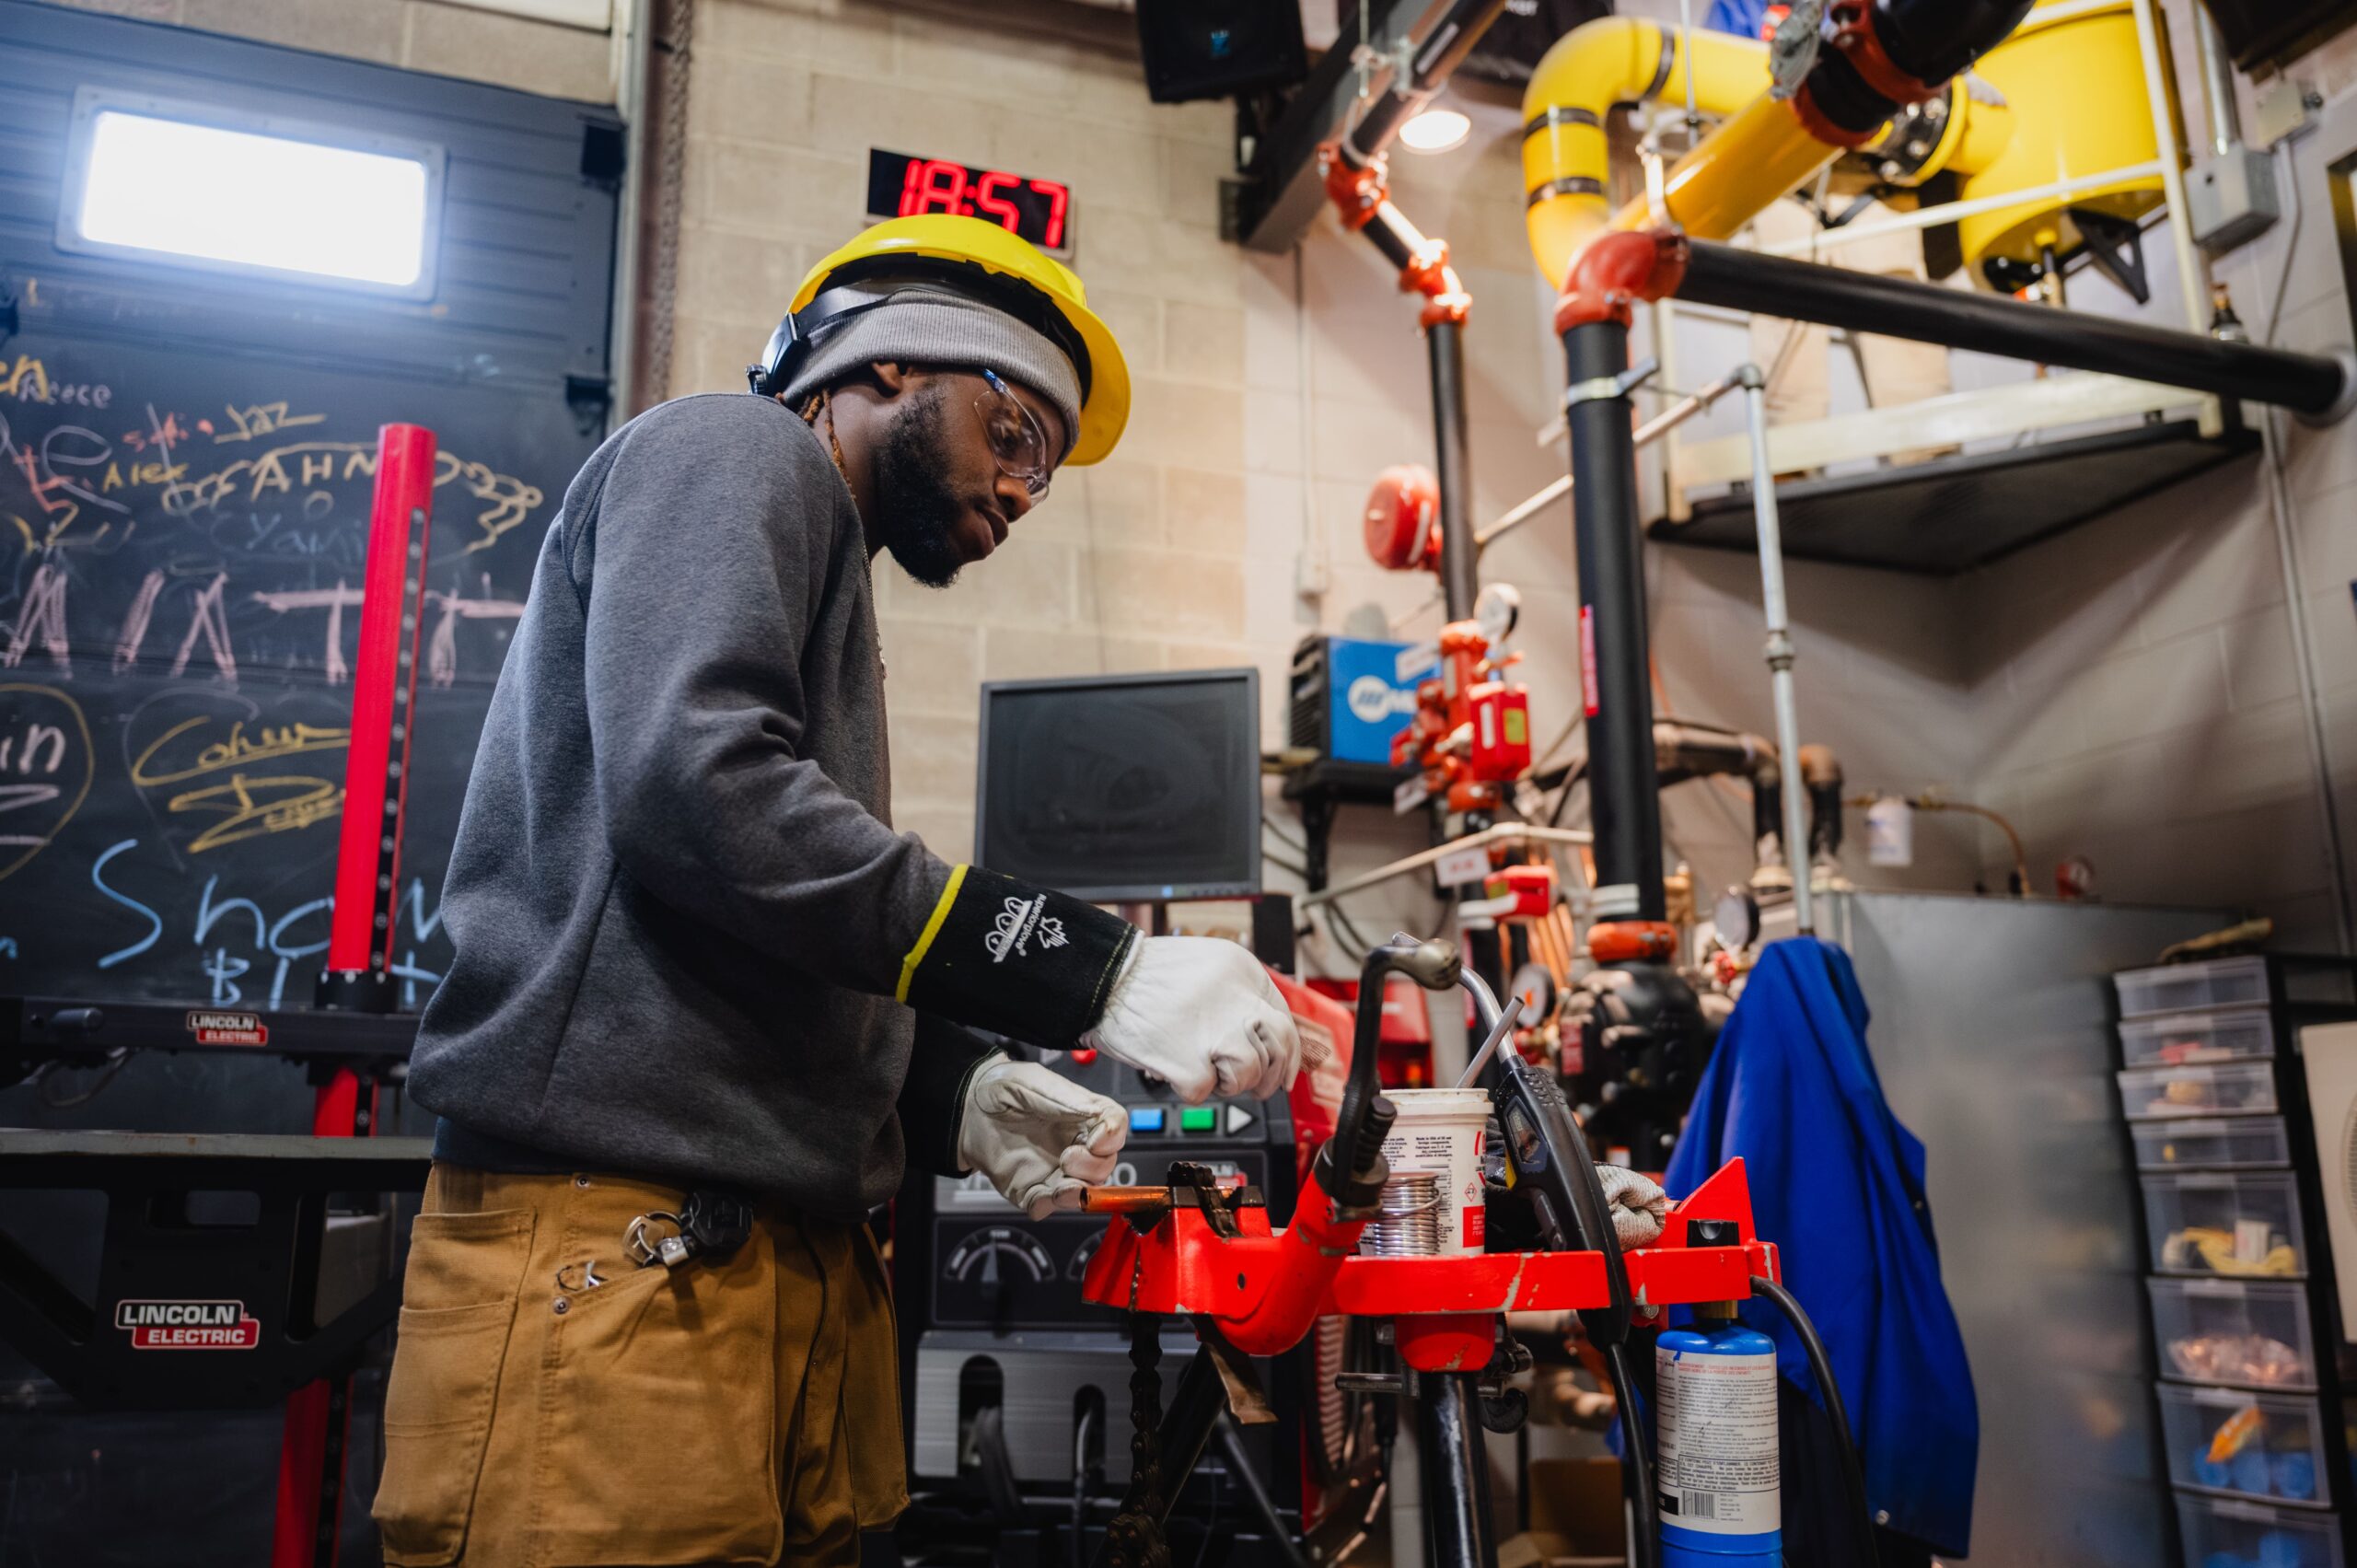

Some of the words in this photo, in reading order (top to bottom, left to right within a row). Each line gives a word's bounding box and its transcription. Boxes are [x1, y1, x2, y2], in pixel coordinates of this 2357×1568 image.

[899, 158, 1068, 249] 18:57
[190, 1015, 255, 1030] LINCOLN
[205, 1030, 261, 1043] ELECTRIC
[123, 1306, 235, 1324] LINCOLN
[147, 1330, 246, 1344] ELECTRIC
